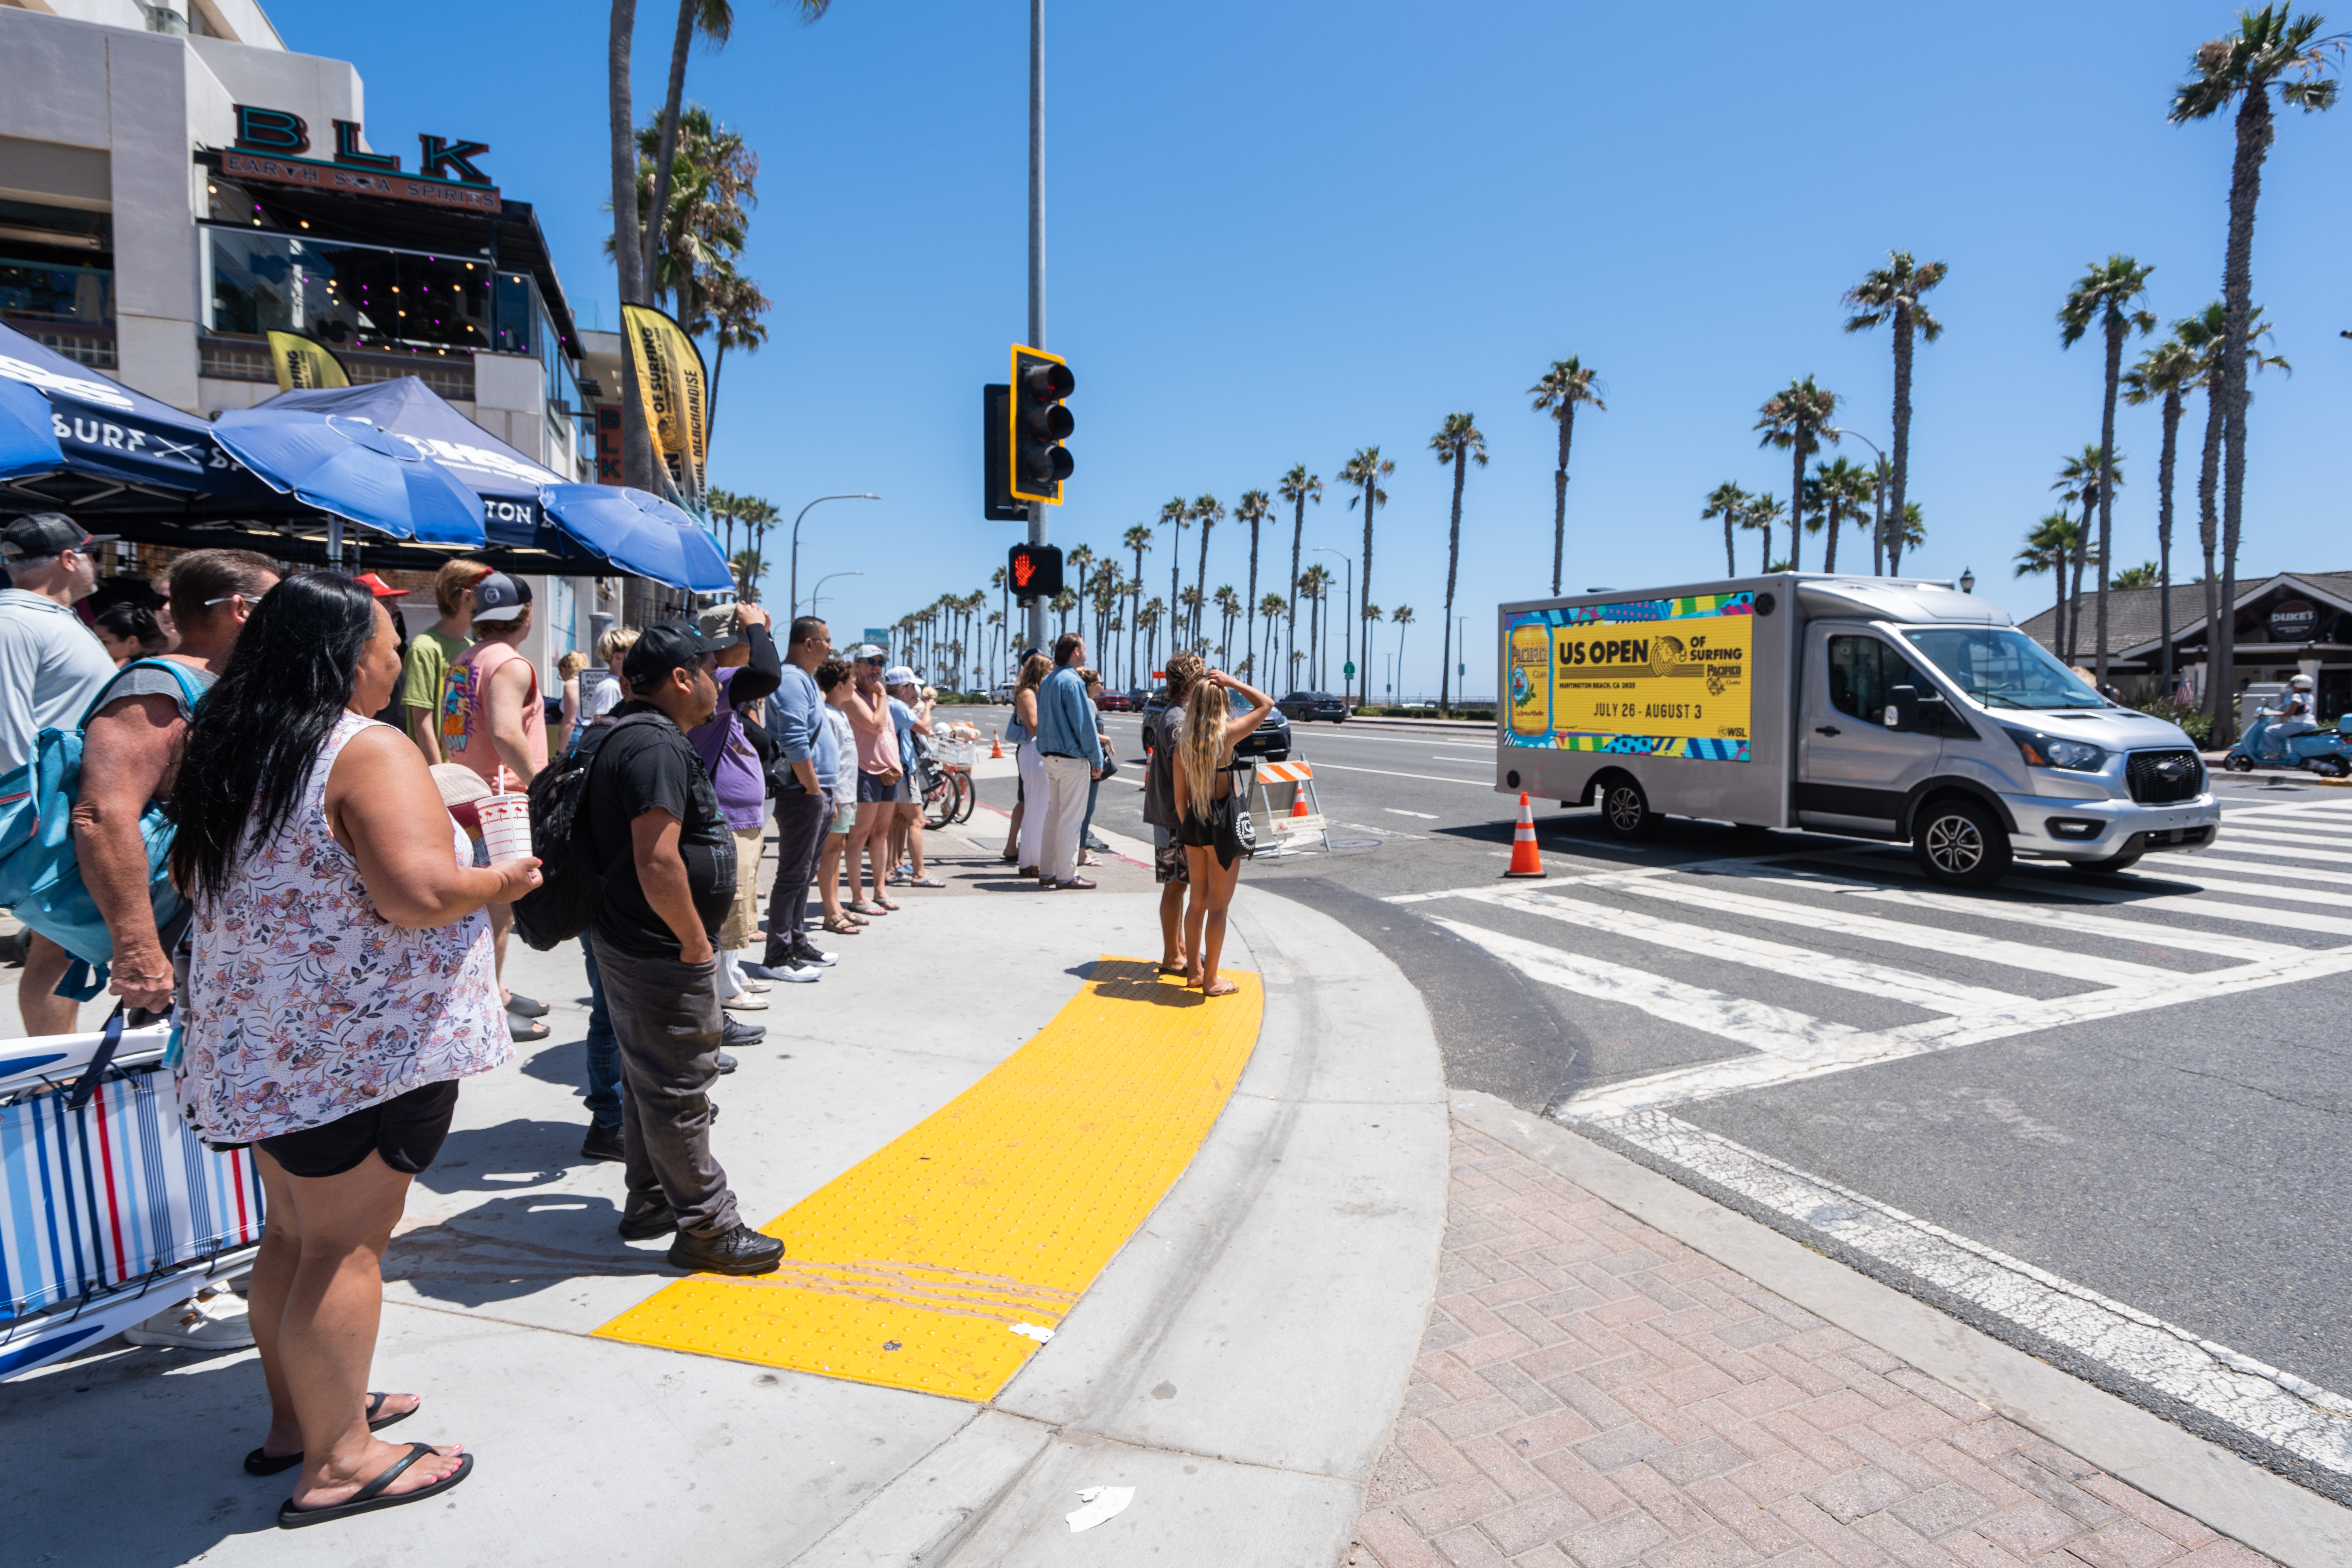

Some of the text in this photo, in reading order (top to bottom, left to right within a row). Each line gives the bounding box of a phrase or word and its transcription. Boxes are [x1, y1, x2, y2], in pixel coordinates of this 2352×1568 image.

[233, 104, 491, 186] BLK
[287, 350, 304, 389] RFING
[642, 327, 665, 413] OF SURFING
[684, 369, 703, 457] MERCHANDISE
[51, 413, 146, 451] SURF
[601, 410, 621, 478] BLK
[2271, 610, 2314, 622] DUKE'S
[1560, 639, 1649, 664] US OPEN
[1690, 636, 1706, 647] OF
[1690, 648, 1743, 661] SURFING
[1707, 664, 1742, 677] PACIFICO
[1594, 703, 1618, 716] JULY
[1622, 703, 1635, 717] 26
[1645, 703, 1690, 719] AUGUST
[1694, 704, 1702, 719] 3
[1728, 727, 1747, 737] WSL
